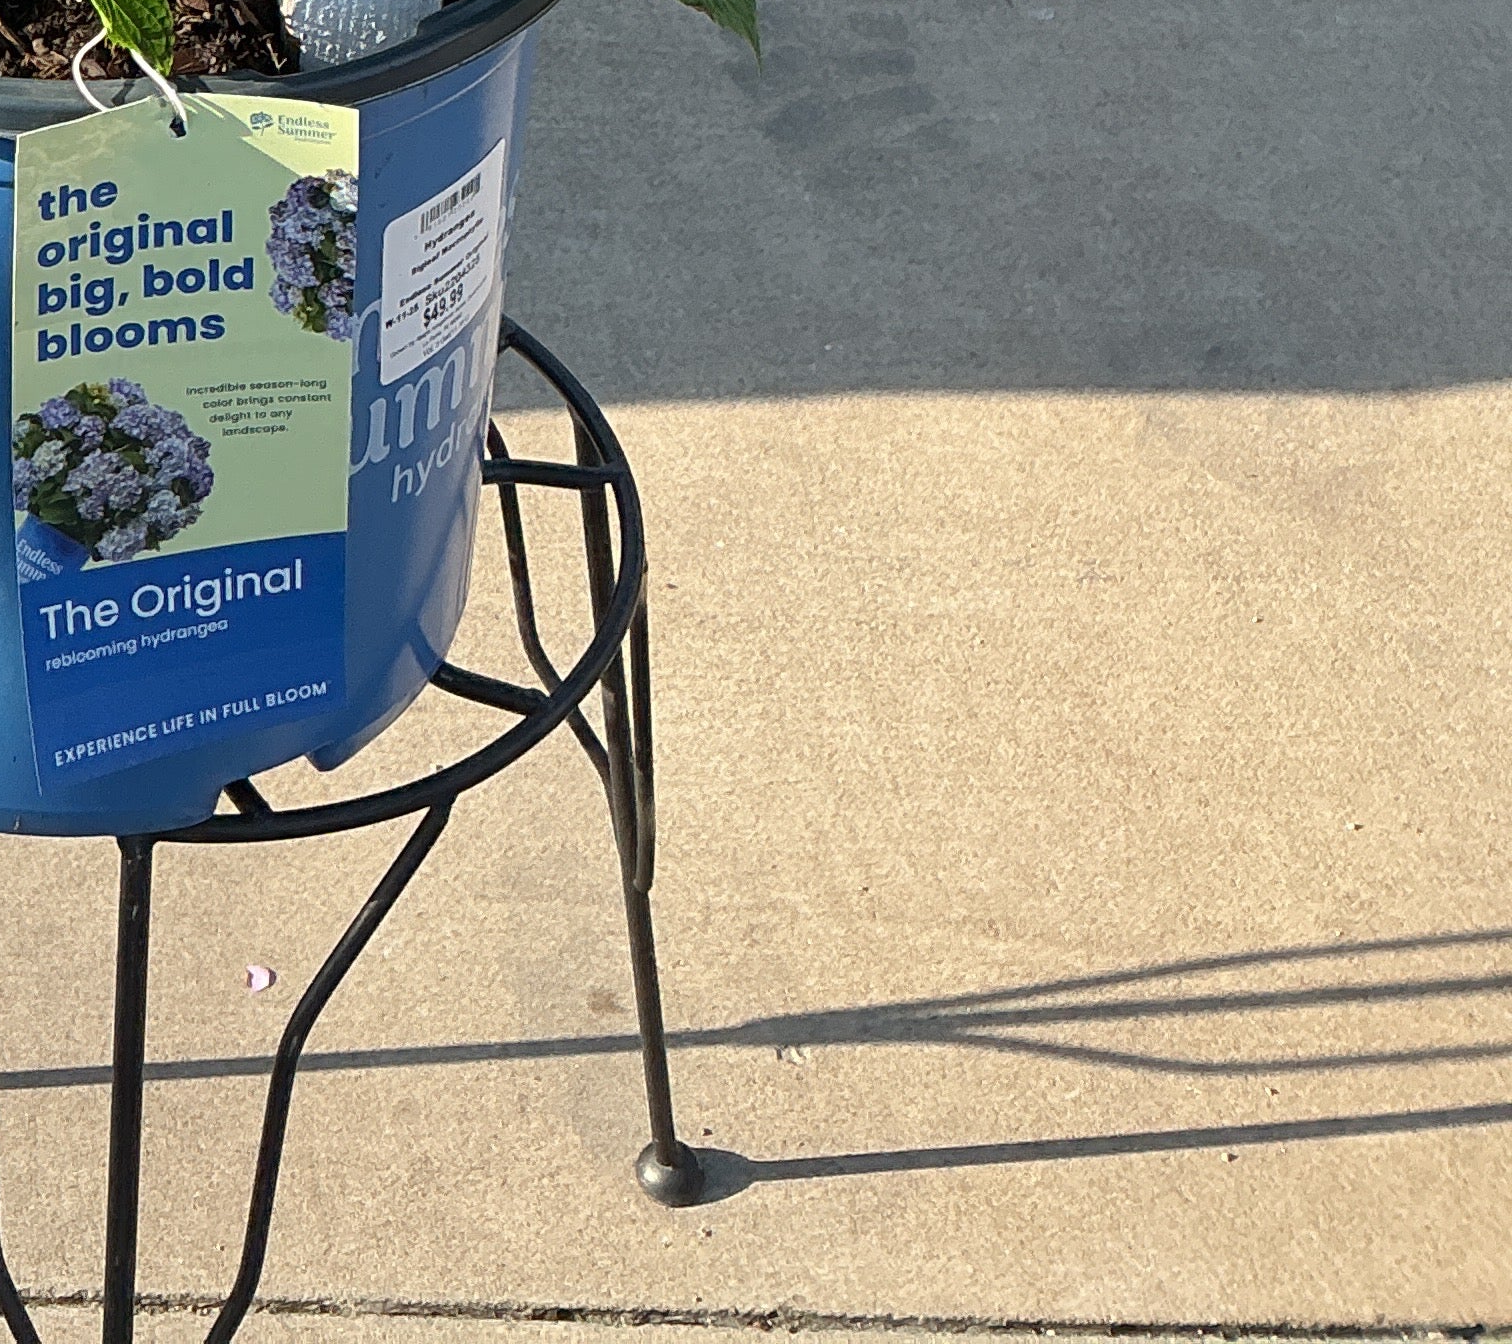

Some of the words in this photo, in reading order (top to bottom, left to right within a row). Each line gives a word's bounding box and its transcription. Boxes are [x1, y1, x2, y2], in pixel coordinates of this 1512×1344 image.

[278, 115, 330, 129] Endless
[278, 126, 337, 140] Summer
[38, 181, 118, 221] the
[38, 210, 233, 268] original
[424, 210, 476, 252] Hydrangea
[38, 273, 129, 316] big,
[143, 257, 254, 298] bold
[423, 282, 465, 329] $49.99
[38, 314, 226, 362] blooms
[202, 398, 233, 409] color
[236, 396, 274, 407] brings
[277, 393, 331, 403] constant
[249, 378, 327, 391] season-long
[209, 411, 251, 424] delight
[255, 411, 267, 419] to
[269, 409, 293, 422] any
[222, 424, 288, 437] landscape.
[40, 599, 120, 640] The
[131, 559, 302, 618] Original
[45, 636, 138, 672] reblooming
[140, 619, 229, 650] hydrangea
[54, 723, 158, 767] EXPERIENCE
[161, 712, 194, 734] LIFE
[199, 708, 217, 725] IN
[222, 697, 261, 719] FULL
[265, 681, 328, 707] BLOOM
